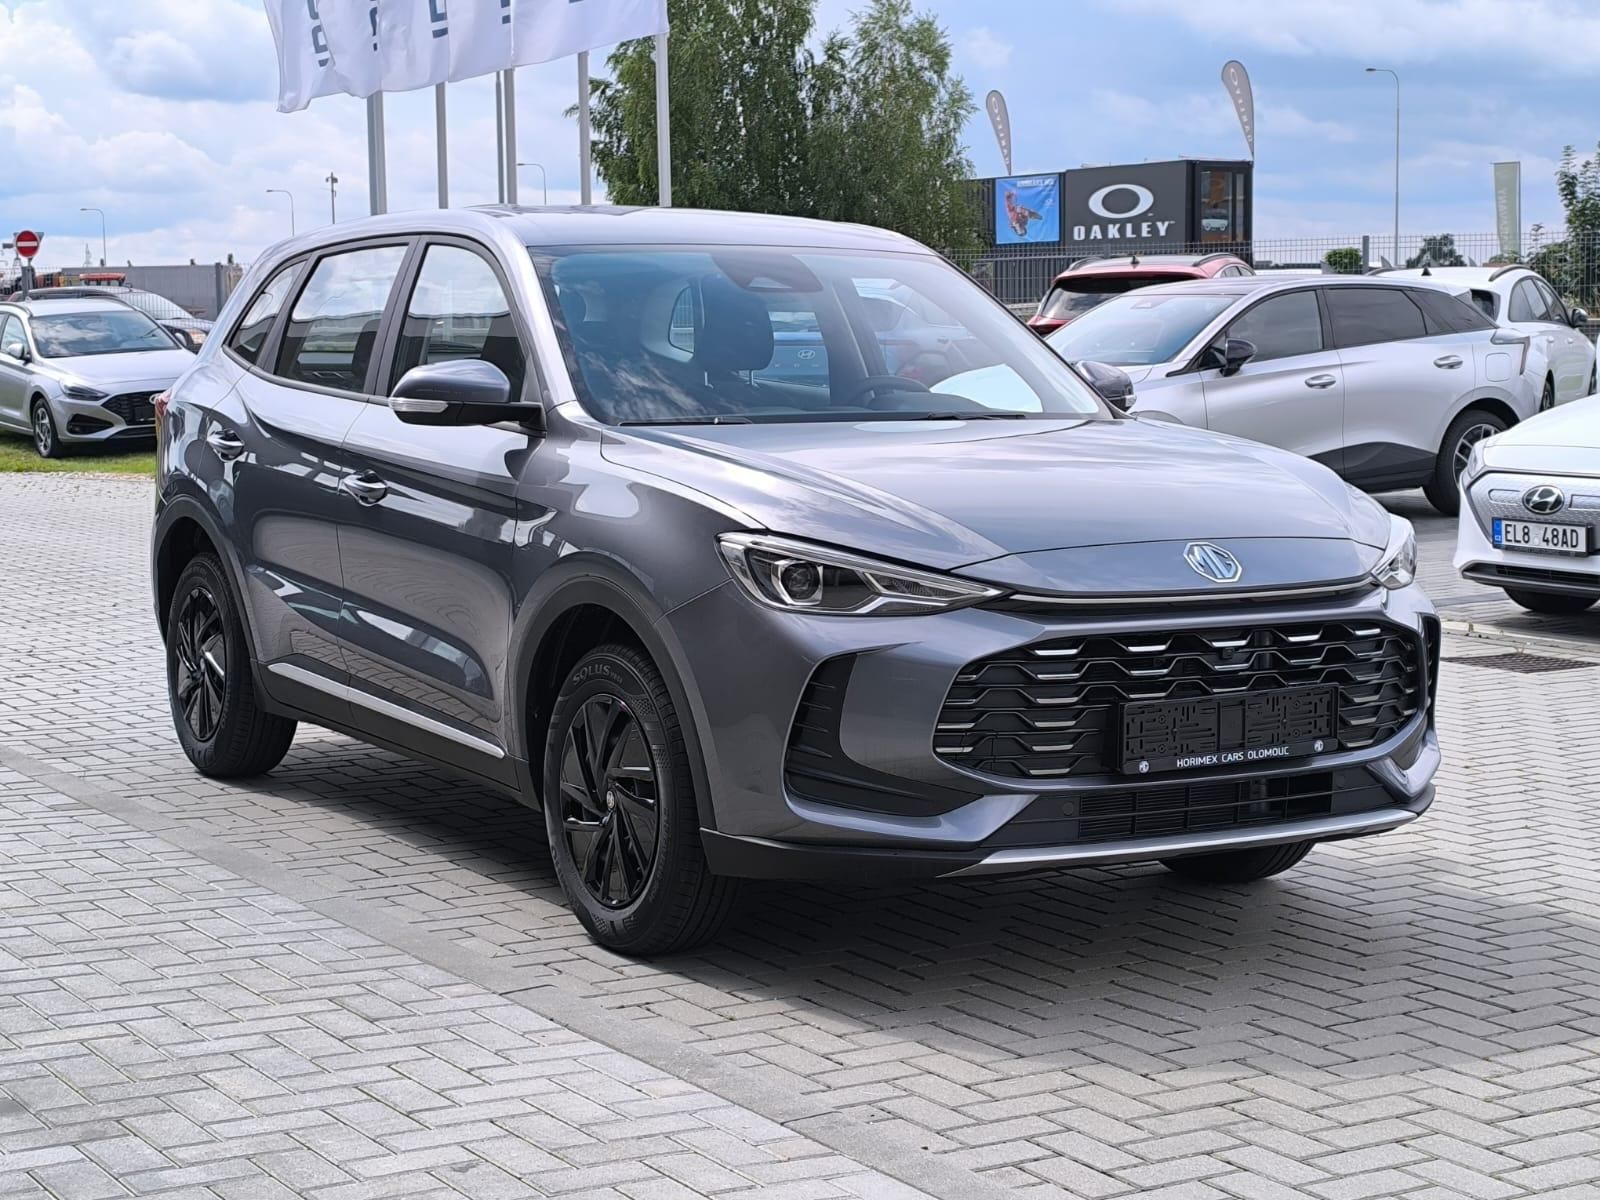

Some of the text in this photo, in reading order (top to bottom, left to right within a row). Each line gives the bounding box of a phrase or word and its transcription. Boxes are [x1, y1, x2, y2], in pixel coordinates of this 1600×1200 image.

[1073, 221, 1170, 241] OAKLEY
[1504, 523, 1580, 549] EL8 48AD
[1186, 543, 1238, 580] MG
[572, 663, 611, 686] SOLUS
[1176, 746, 1289, 768] HORIMEX CARS OLOMOUC
